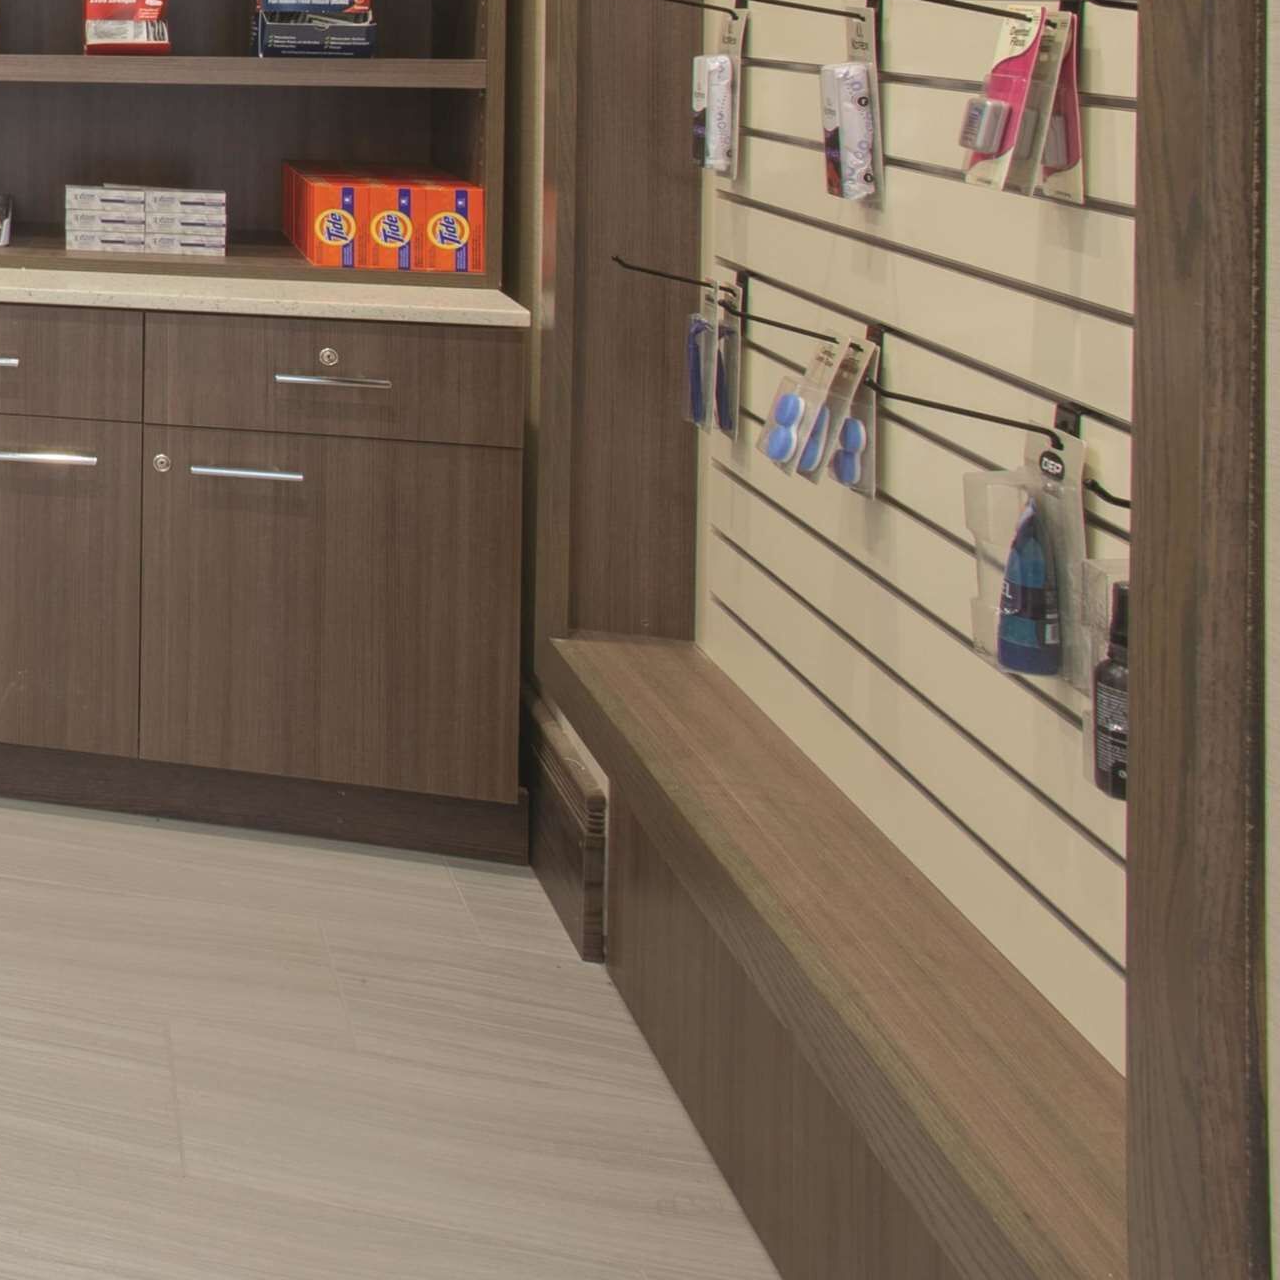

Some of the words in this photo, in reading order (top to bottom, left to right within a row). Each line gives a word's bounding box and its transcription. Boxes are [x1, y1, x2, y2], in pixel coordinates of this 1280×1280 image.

[325, 211, 349, 242] Tide
[381, 213, 405, 244] Tide
[438, 215, 462, 245] Tide
[1041, 456, 1063, 475] DEP
